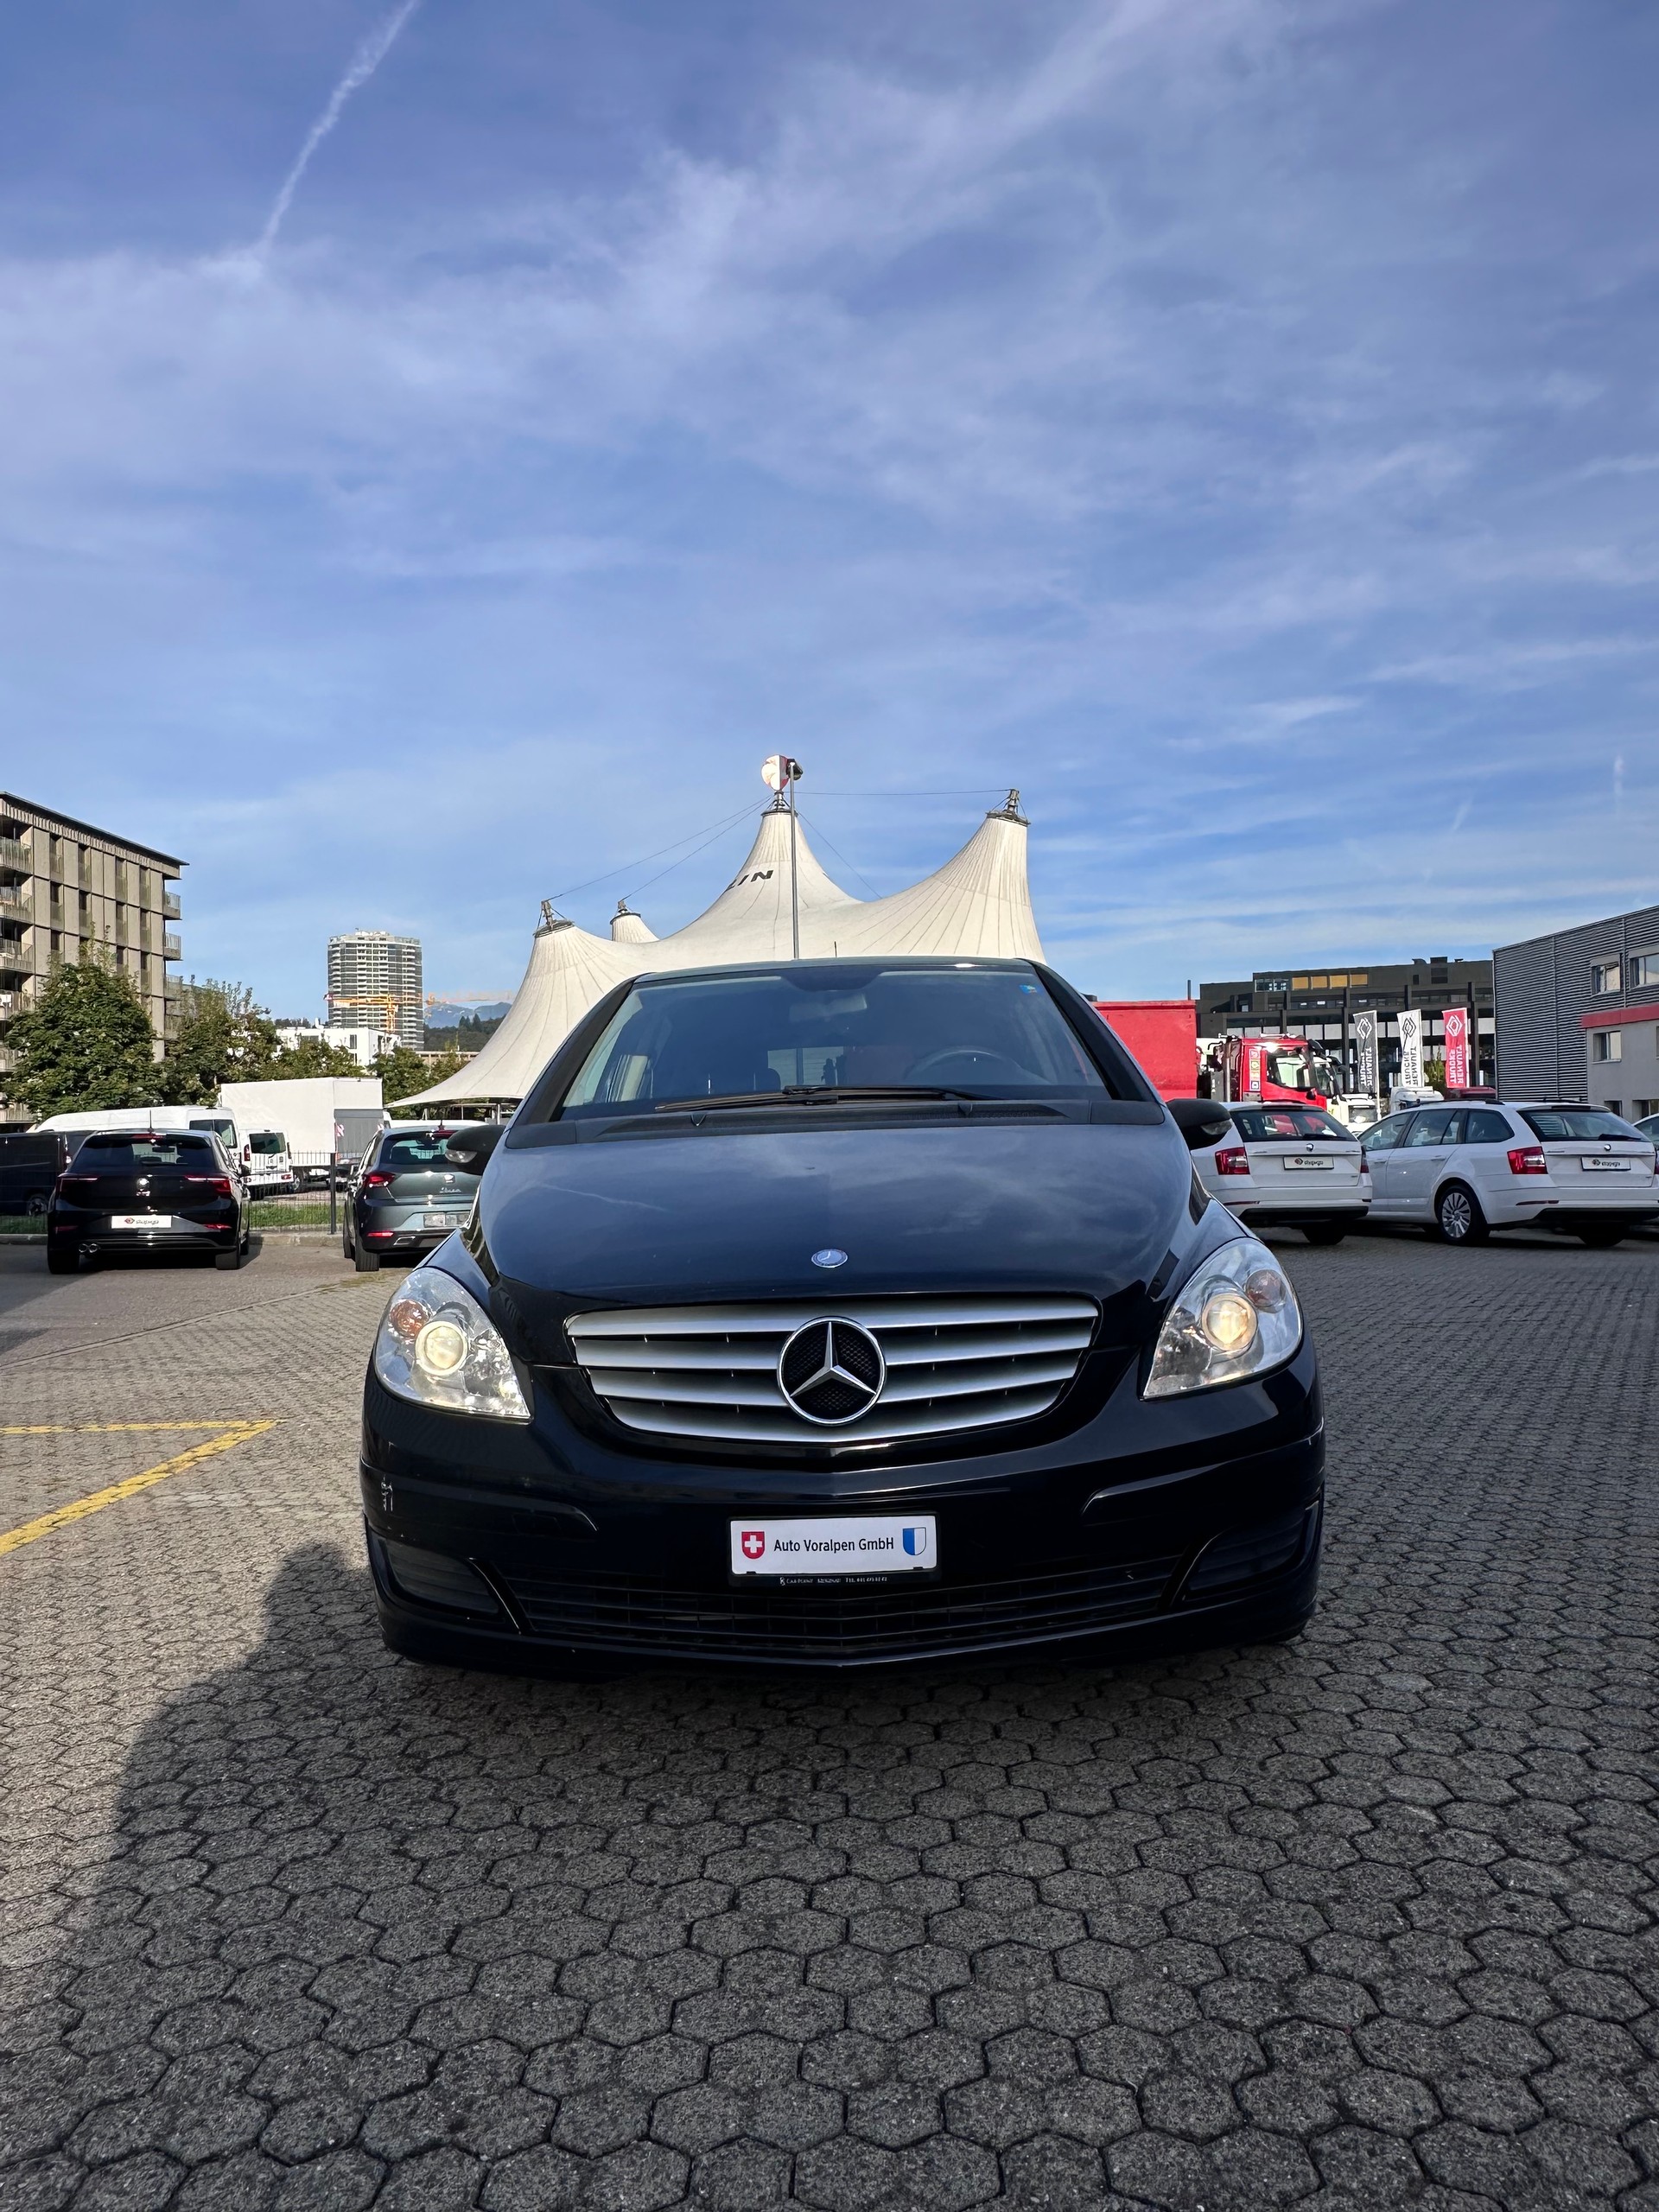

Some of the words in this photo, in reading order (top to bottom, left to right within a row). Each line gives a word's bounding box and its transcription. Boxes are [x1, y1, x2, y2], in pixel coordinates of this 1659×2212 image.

[773, 1539, 801, 1552] Auto
[804, 1538, 855, 1554] Voralpen
[858, 1537, 894, 1551] GmbH
